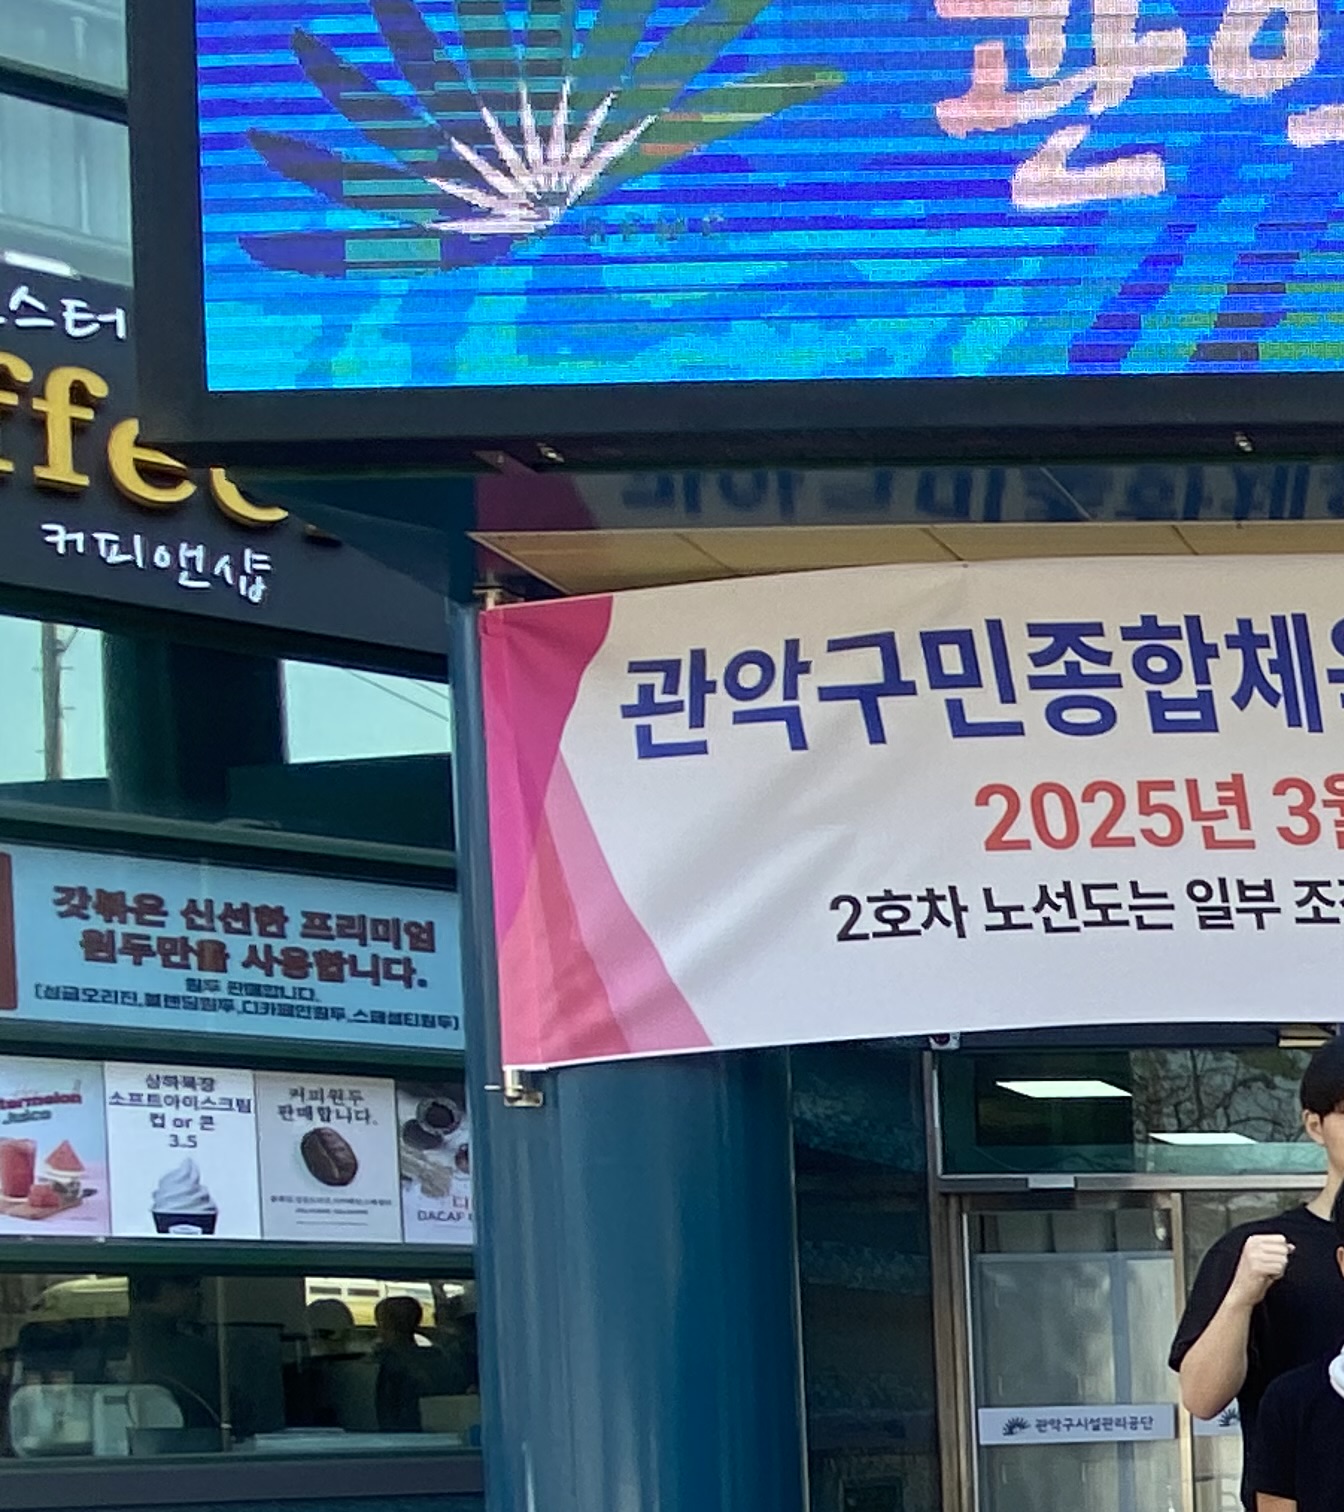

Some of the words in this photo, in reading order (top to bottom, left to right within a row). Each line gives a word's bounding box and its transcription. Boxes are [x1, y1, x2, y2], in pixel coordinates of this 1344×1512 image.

[0, 285, 127, 340] 스터
[974, 772, 1255, 852] 2025년
[180, 897, 289, 940] 신선한
[300, 910, 437, 953] 프리미엄
[829, 884, 969, 942] 2호차
[982, 880, 1176, 934] 노선도는
[1186, 877, 1282, 930] 일부
[79, 928, 230, 973] 원두만을
[241, 943, 429, 990] 사용합니다.
[172, 1117, 192, 1129] or
[1036, 1416, 1154, 1433] 관악구시설관리공단
